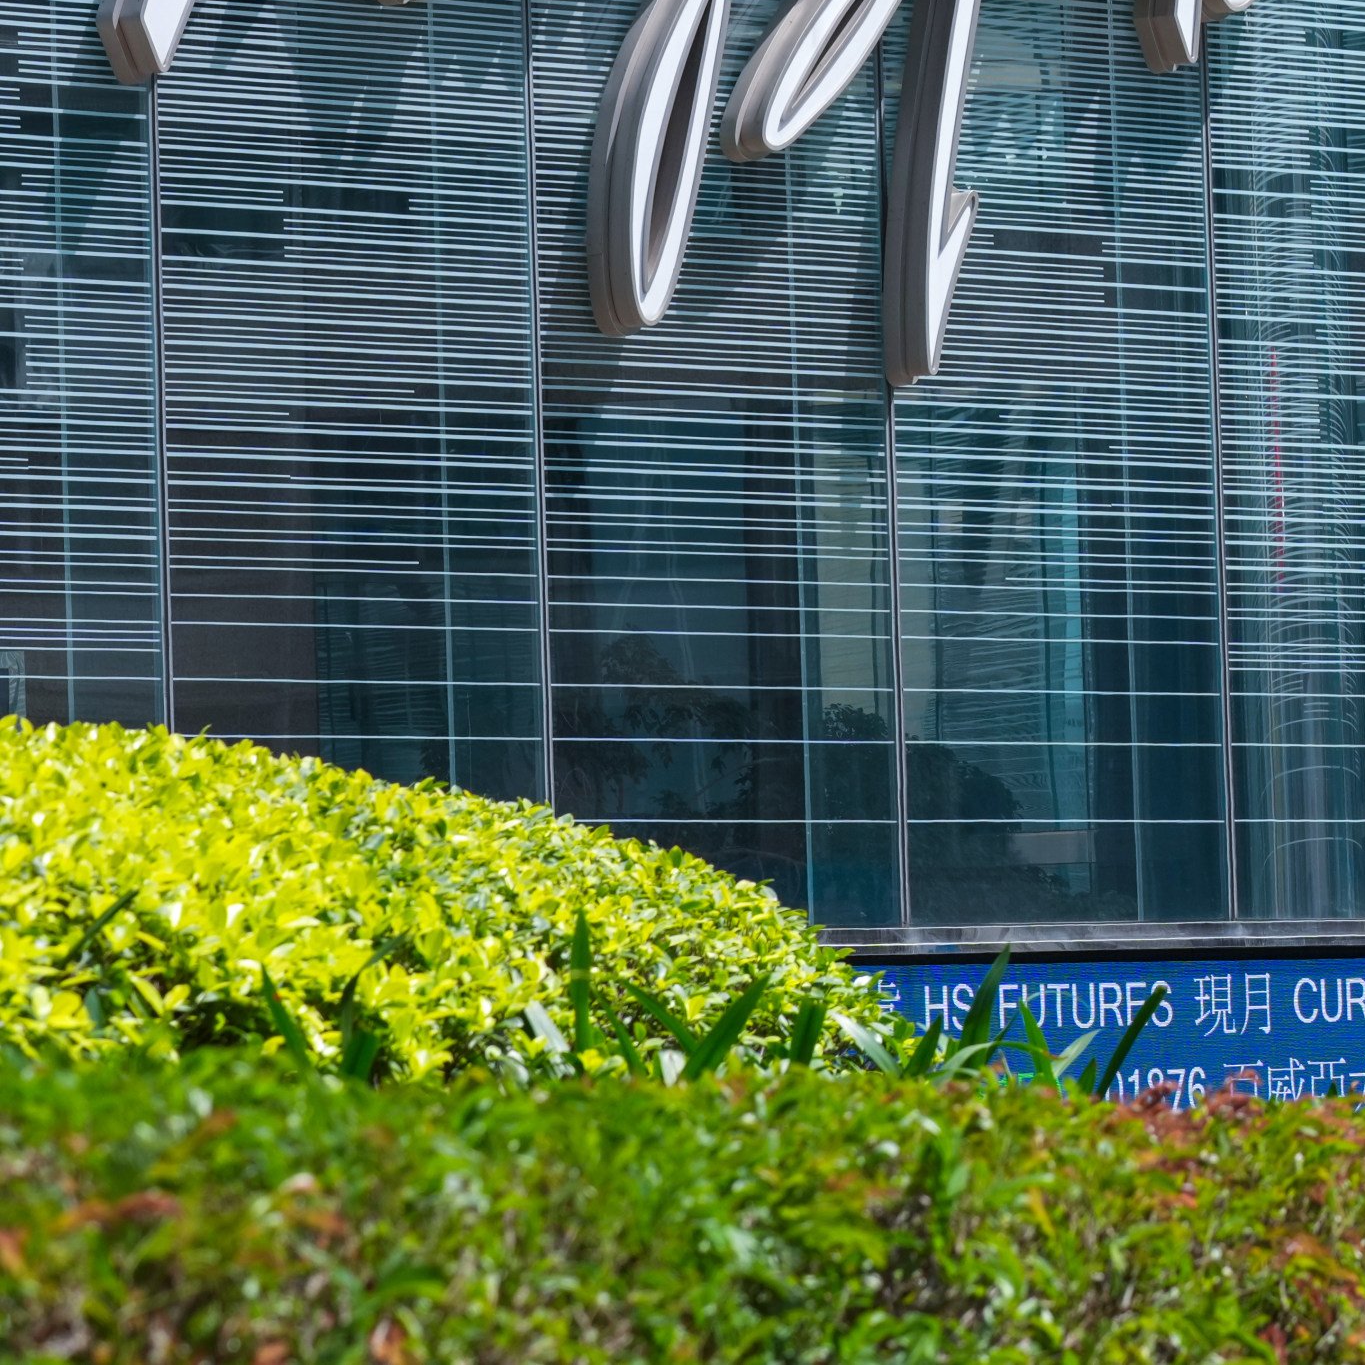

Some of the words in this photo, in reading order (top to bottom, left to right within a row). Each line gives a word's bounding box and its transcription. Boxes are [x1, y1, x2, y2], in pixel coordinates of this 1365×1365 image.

[924, 984, 984, 1031] HS
[998, 980, 1174, 1029] FUTURES
[1193, 972, 1271, 1036] 現月
